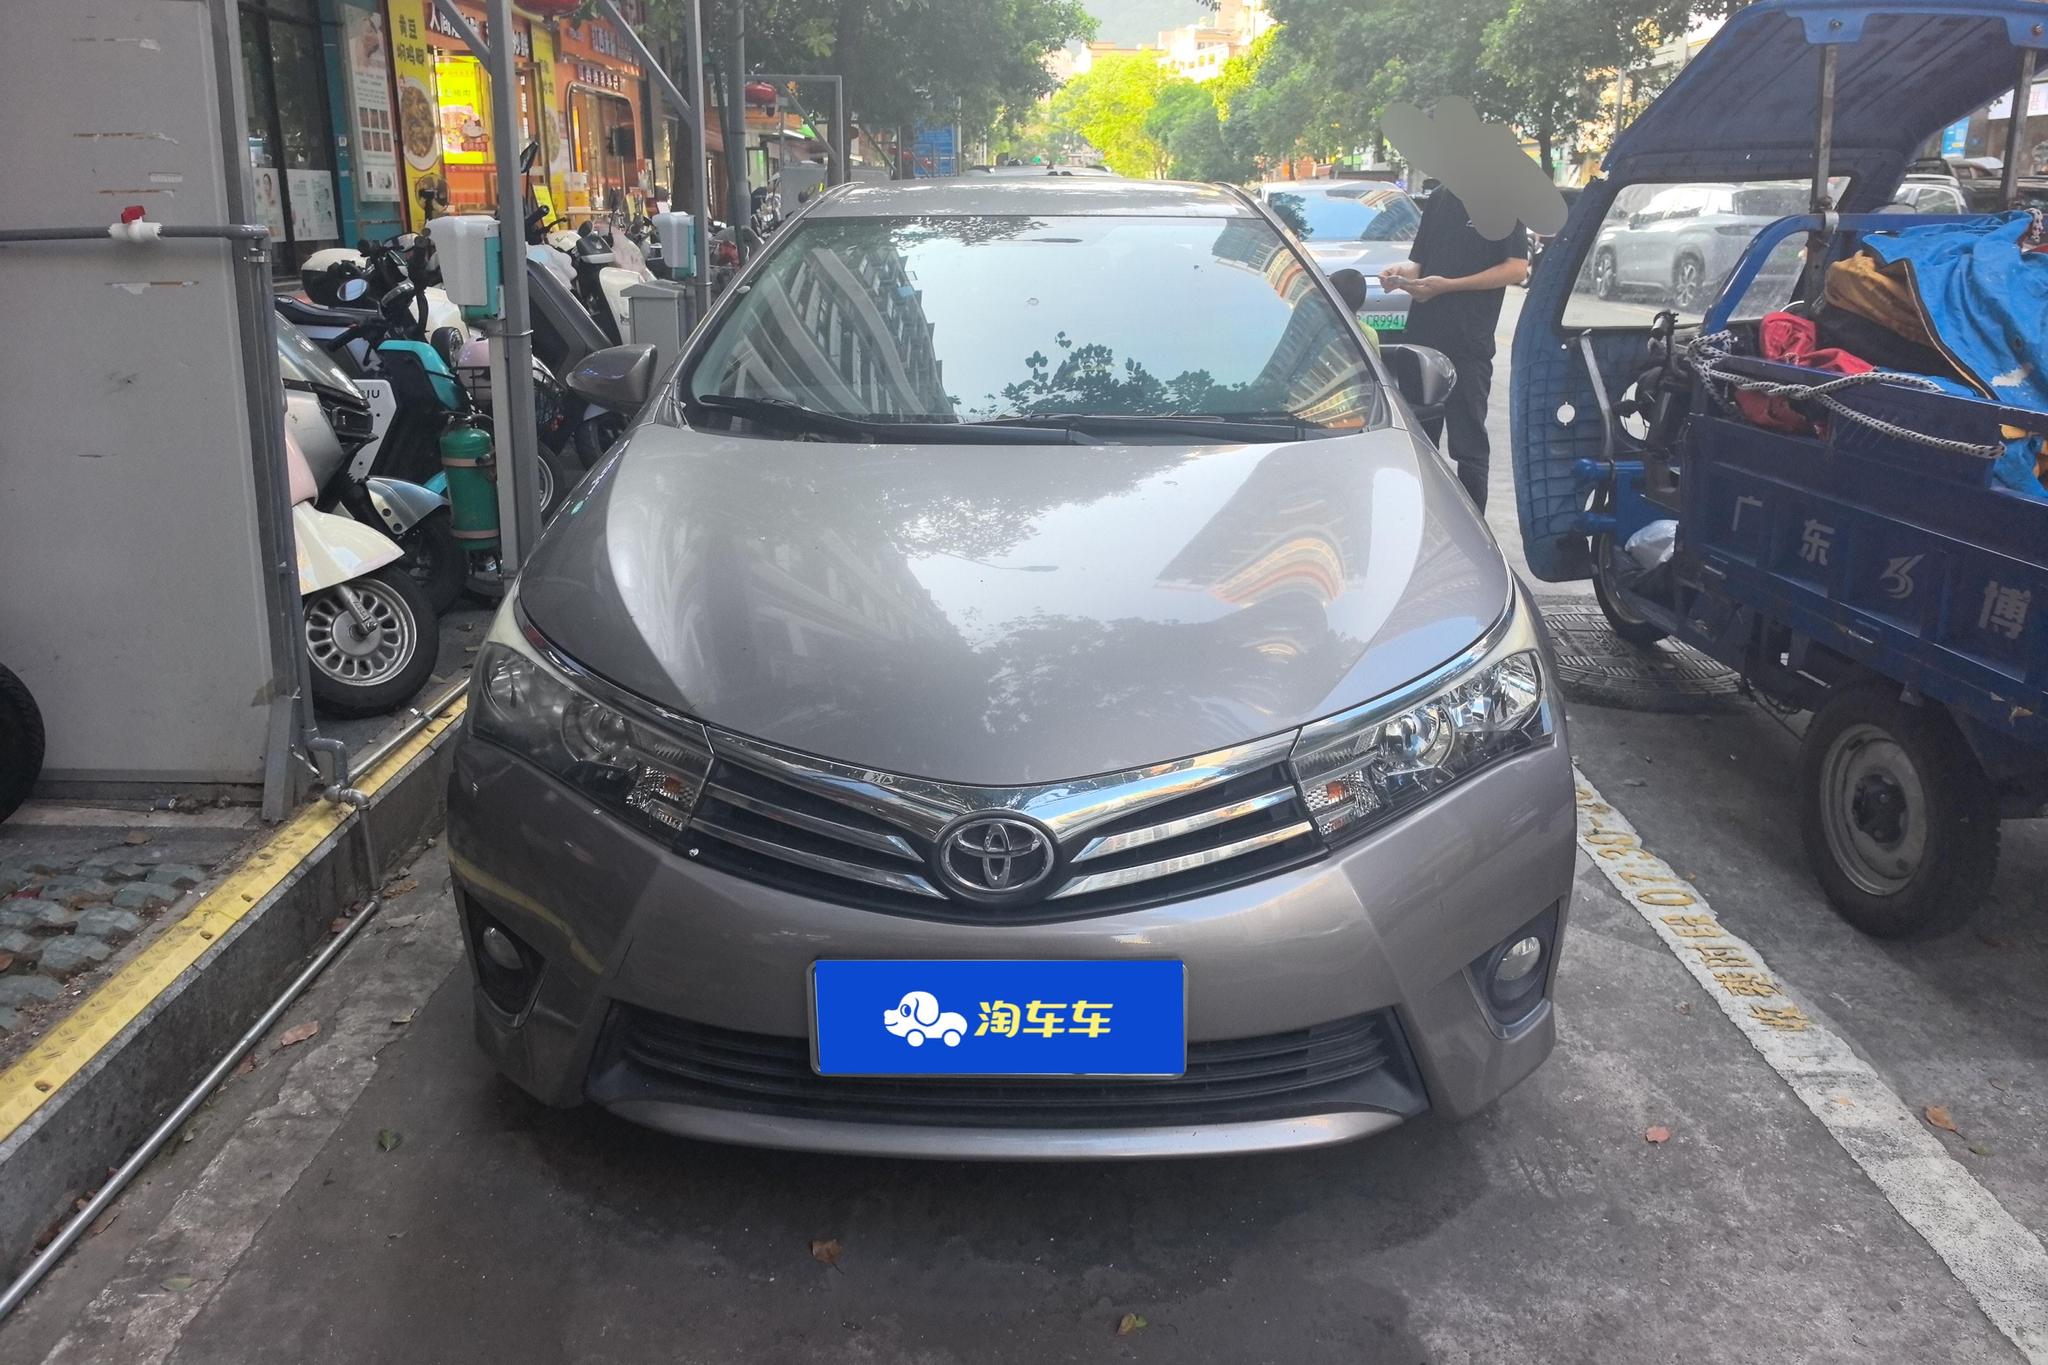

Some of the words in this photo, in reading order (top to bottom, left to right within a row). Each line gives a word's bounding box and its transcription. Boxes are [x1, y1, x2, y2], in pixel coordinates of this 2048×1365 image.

[365, 389, 380, 399] IU
[1978, 580, 2032, 639] 博
[1659, 914, 1810, 1032] 收费时段
